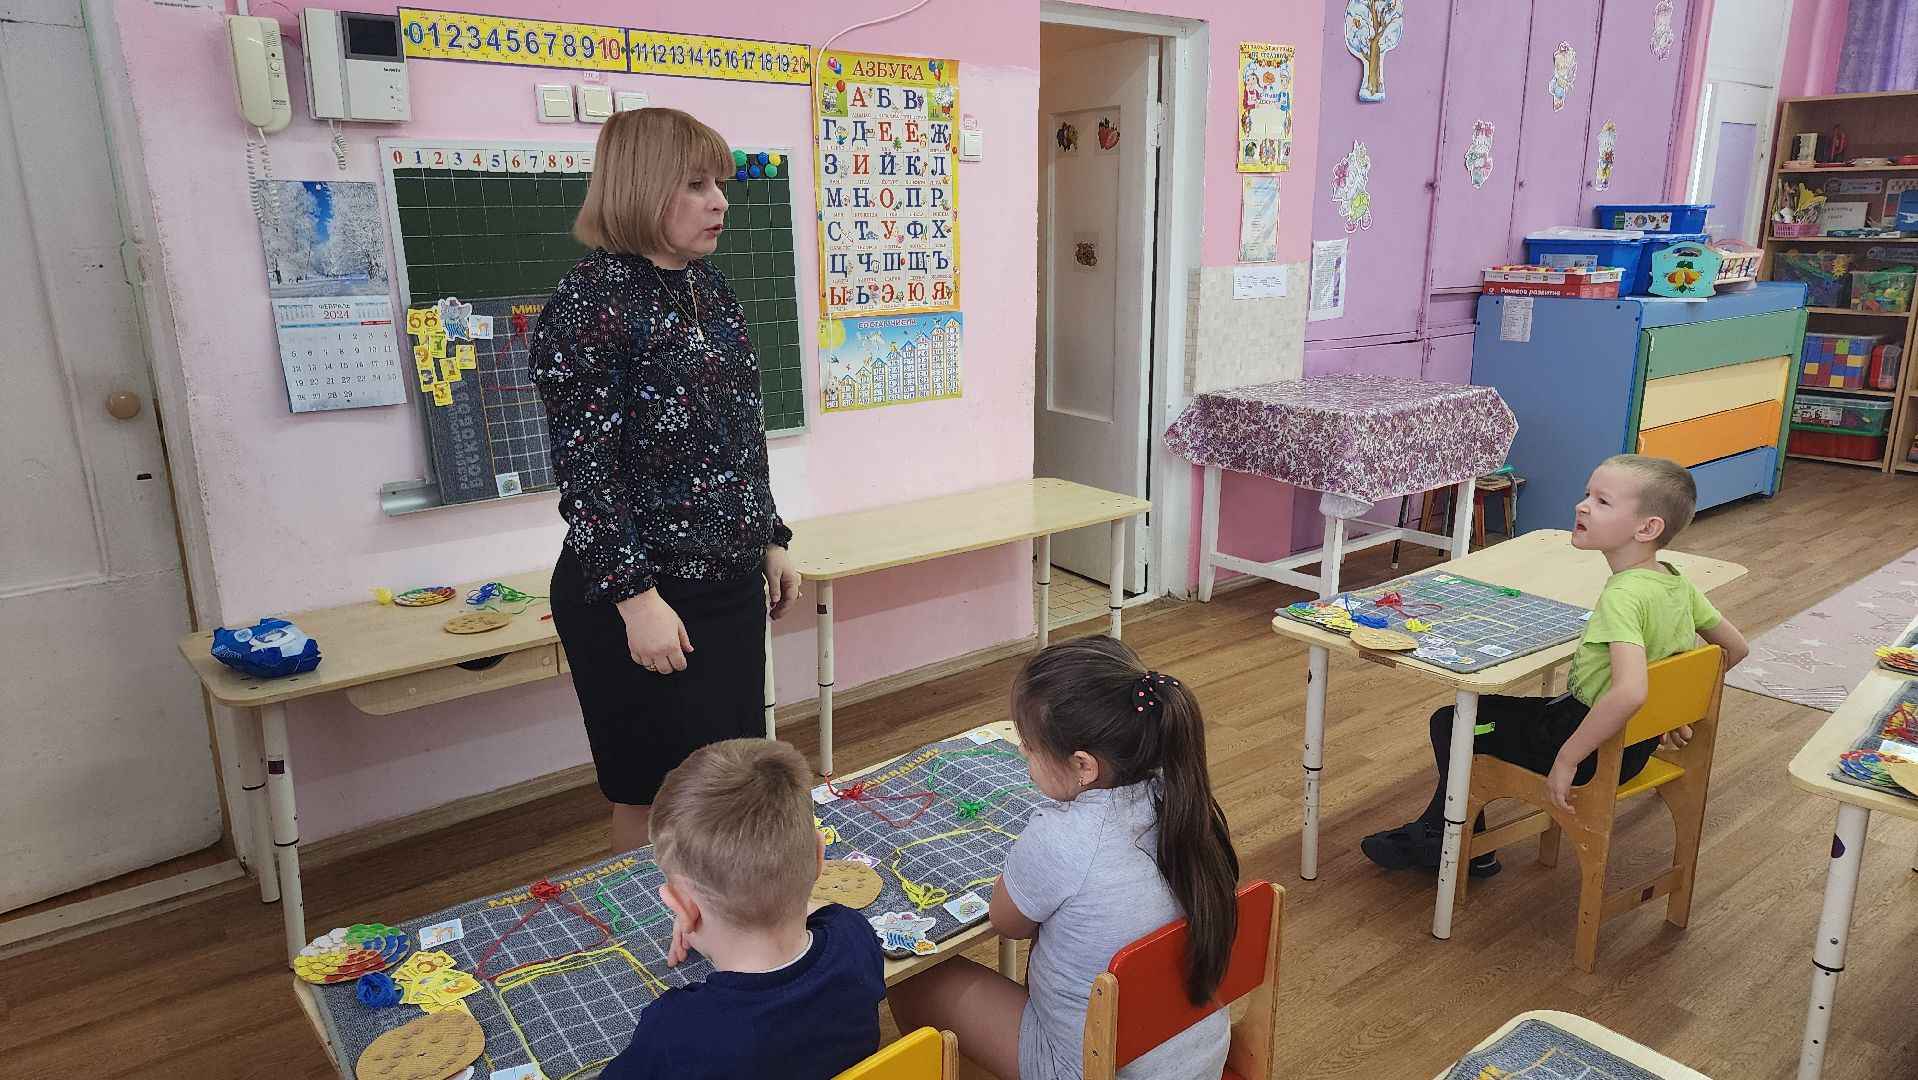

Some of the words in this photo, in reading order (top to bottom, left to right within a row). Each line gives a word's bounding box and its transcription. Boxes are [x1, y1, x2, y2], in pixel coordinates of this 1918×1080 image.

[408, 21, 424, 45] 0
[428, 22, 440, 47] 1
[448, 23, 463, 49] 2
[467, 25, 482, 50] 3
[486, 27, 501, 52] 4
[506, 28, 521, 52] 5
[525, 30, 540, 54] 6
[544, 32, 557, 56] 7
[563, 34, 577, 57] 8
[582, 34, 595, 58] 9
[599, 35, 621, 62] 10
[635, 42, 648, 62] 11
[651, 44, 666, 63] 12
[670, 46, 684, 64] 13
[689, 47, 703, 66] 14
[707, 48, 721, 67] 15
[725, 50, 738, 69] 16
[742, 51, 755, 70] 17
[760, 52, 773, 71] 18
[776, 54, 789, 72] 19
[791, 55, 806, 74] 20
[852, 60, 924, 80] АЗБУКА
[850, 87, 868, 108] А
[876, 88, 892, 108] Б
[903, 90, 917, 110] В
[823, 118, 836, 140] Г
[852, 121, 868, 146] Д
[878, 122, 892, 142] Е
[905, 120, 920, 142] Ё
[930, 124, 948, 144] Ж
[392, 151, 403, 164] 0
[414, 151, 422, 164] 1
[434, 152, 444, 164] 2
[454, 152, 463, 165] 3
[473, 153, 481, 166] 4
[492, 155, 500, 168] 5
[512, 156, 520, 168] 6
[530, 156, 537, 168] 7
[548, 155, 556, 168] 8
[566, 156, 573, 168] 9
[824, 154, 838, 174] З
[852, 154, 870, 174] И
[879, 152, 896, 175] Й
[906, 156, 920, 176] К
[931, 156, 945, 176] Л
[826, 188, 842, 208] М
[852, 188, 870, 208] Н
[880, 188, 894, 208] О
[905, 188, 922, 208] П
[930, 188, 944, 208] Р
[828, 221, 842, 242] С
[855, 220, 868, 241] Т
[881, 220, 896, 240] У
[907, 220, 924, 238] Ф
[932, 220, 947, 238] Х
[830, 254, 848, 278] Ц
[857, 253, 872, 272] Ч
[883, 252, 901, 272] Ш
[908, 252, 928, 274] Щ
[933, 251, 948, 270] Ъ
[830, 286, 848, 306] Ы
[856, 286, 870, 305] Ь
[882, 284, 894, 303] Э
[908, 282, 924, 302] Ю
[932, 282, 946, 300] Я
[324, 310, 350, 320] 2024
[858, 320, 888, 328] СОСТАВ
[890, 318, 916, 327] ЧИСЛА
